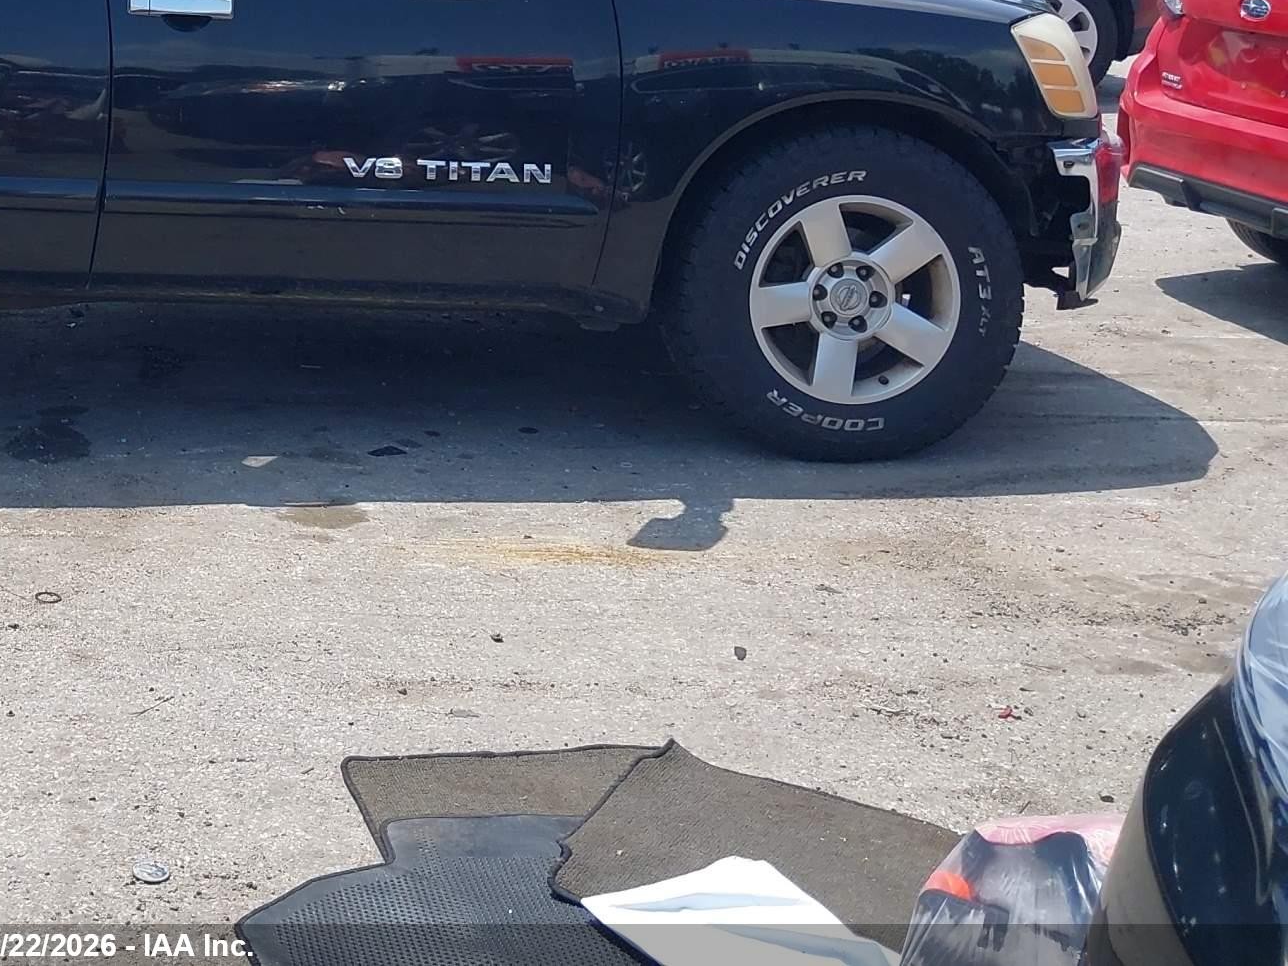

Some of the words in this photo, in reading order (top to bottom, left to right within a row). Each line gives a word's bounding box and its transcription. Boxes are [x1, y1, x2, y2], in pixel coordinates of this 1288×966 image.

[343, 157, 403, 179] V8
[417, 158, 552, 185] TITAN
[733, 169, 868, 271] DISCOVERER
[967, 246, 993, 300] AT3
[765, 388, 885, 433] COOPER
